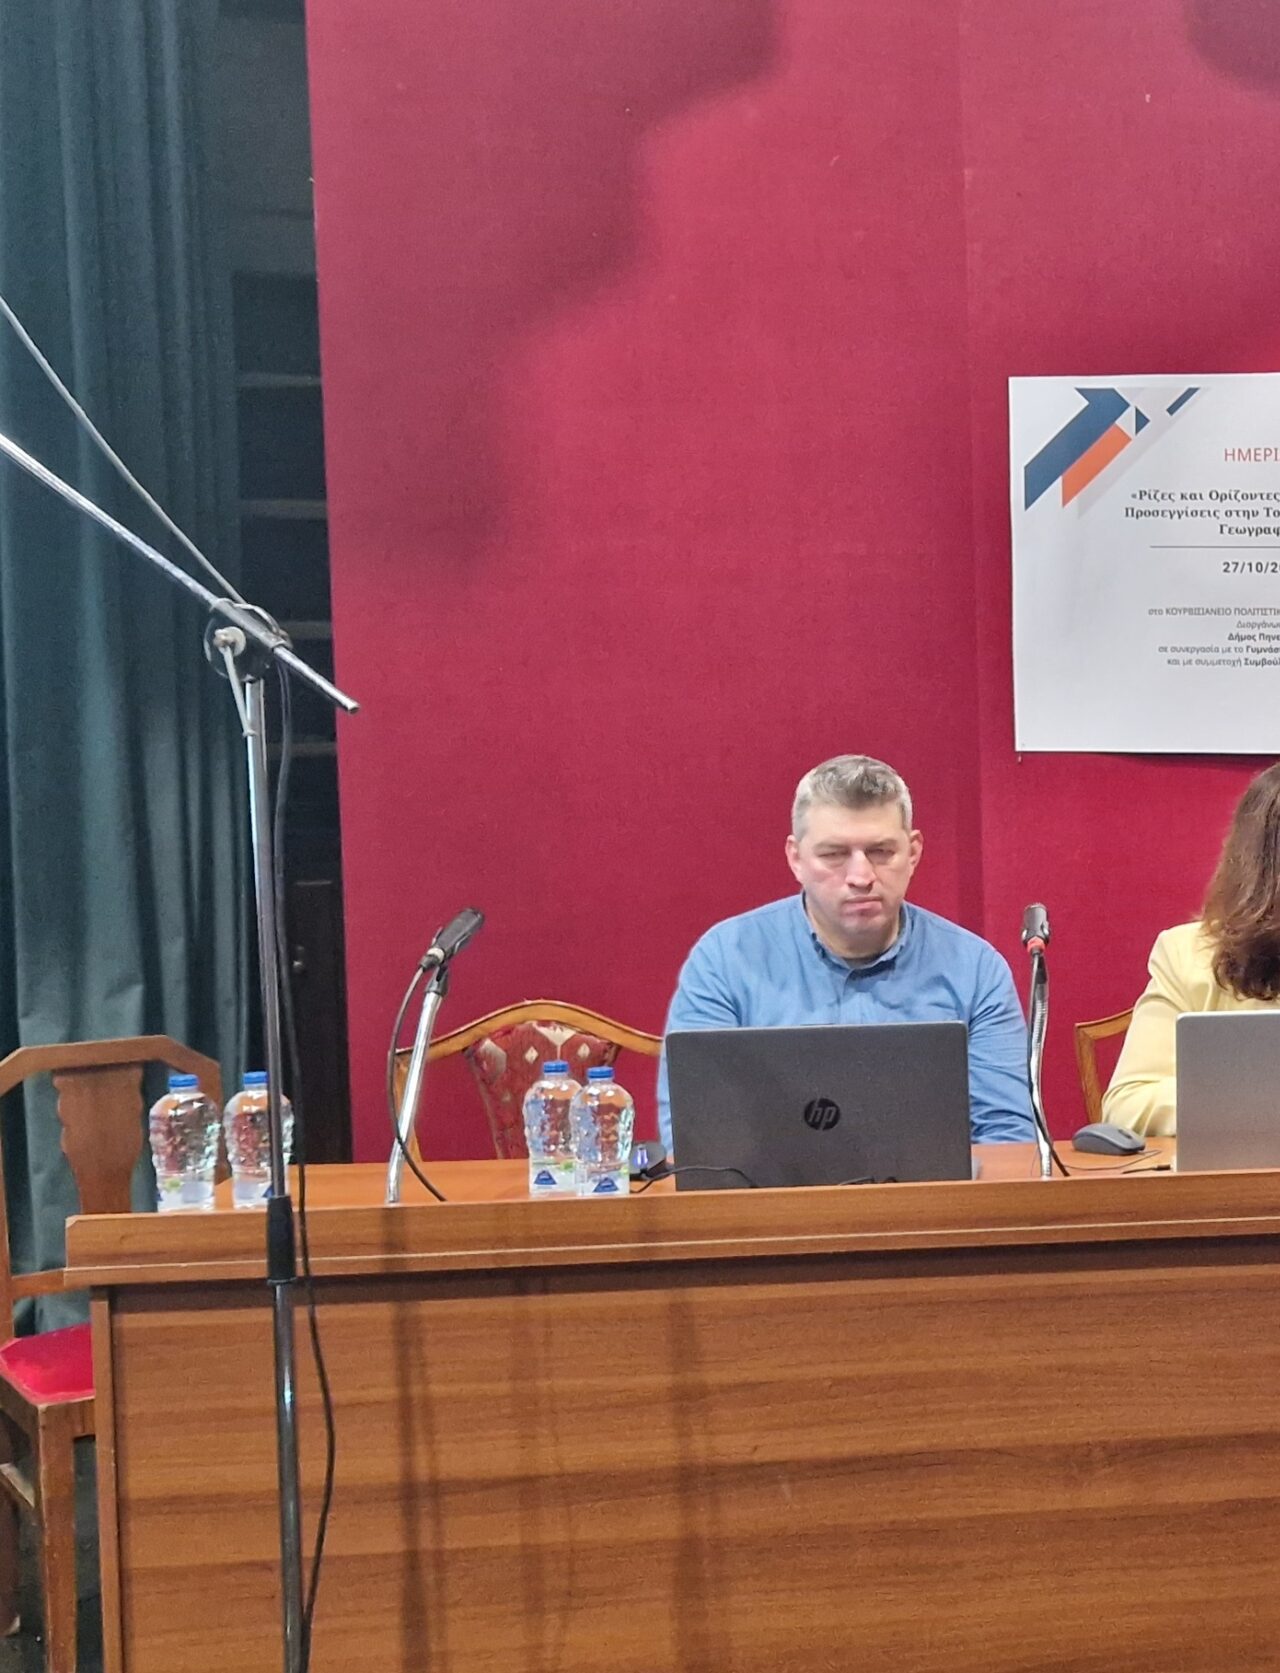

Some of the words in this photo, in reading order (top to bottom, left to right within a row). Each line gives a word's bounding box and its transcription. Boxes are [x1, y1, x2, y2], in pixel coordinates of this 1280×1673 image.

[1131, 489, 1176, 503] «Ρίζες
[1180, 491, 1204, 501] και
[1124, 506, 1220, 520] Προσεγγίσεις
[1224, 508, 1259, 520] στην
[1148, 608, 1163, 616] στο
[1228, 632, 1257, 642] Δήμος
[1158, 645, 1168, 653] σε
[1170, 644, 1219, 654] συνεργασία
[1221, 646, 1231, 654] με
[1167, 658, 1180, 666] και
[1183, 659, 1193, 667] με
[1195, 657, 1242, 667] συμμετοχή
[805, 1098, 839, 1131] hp
